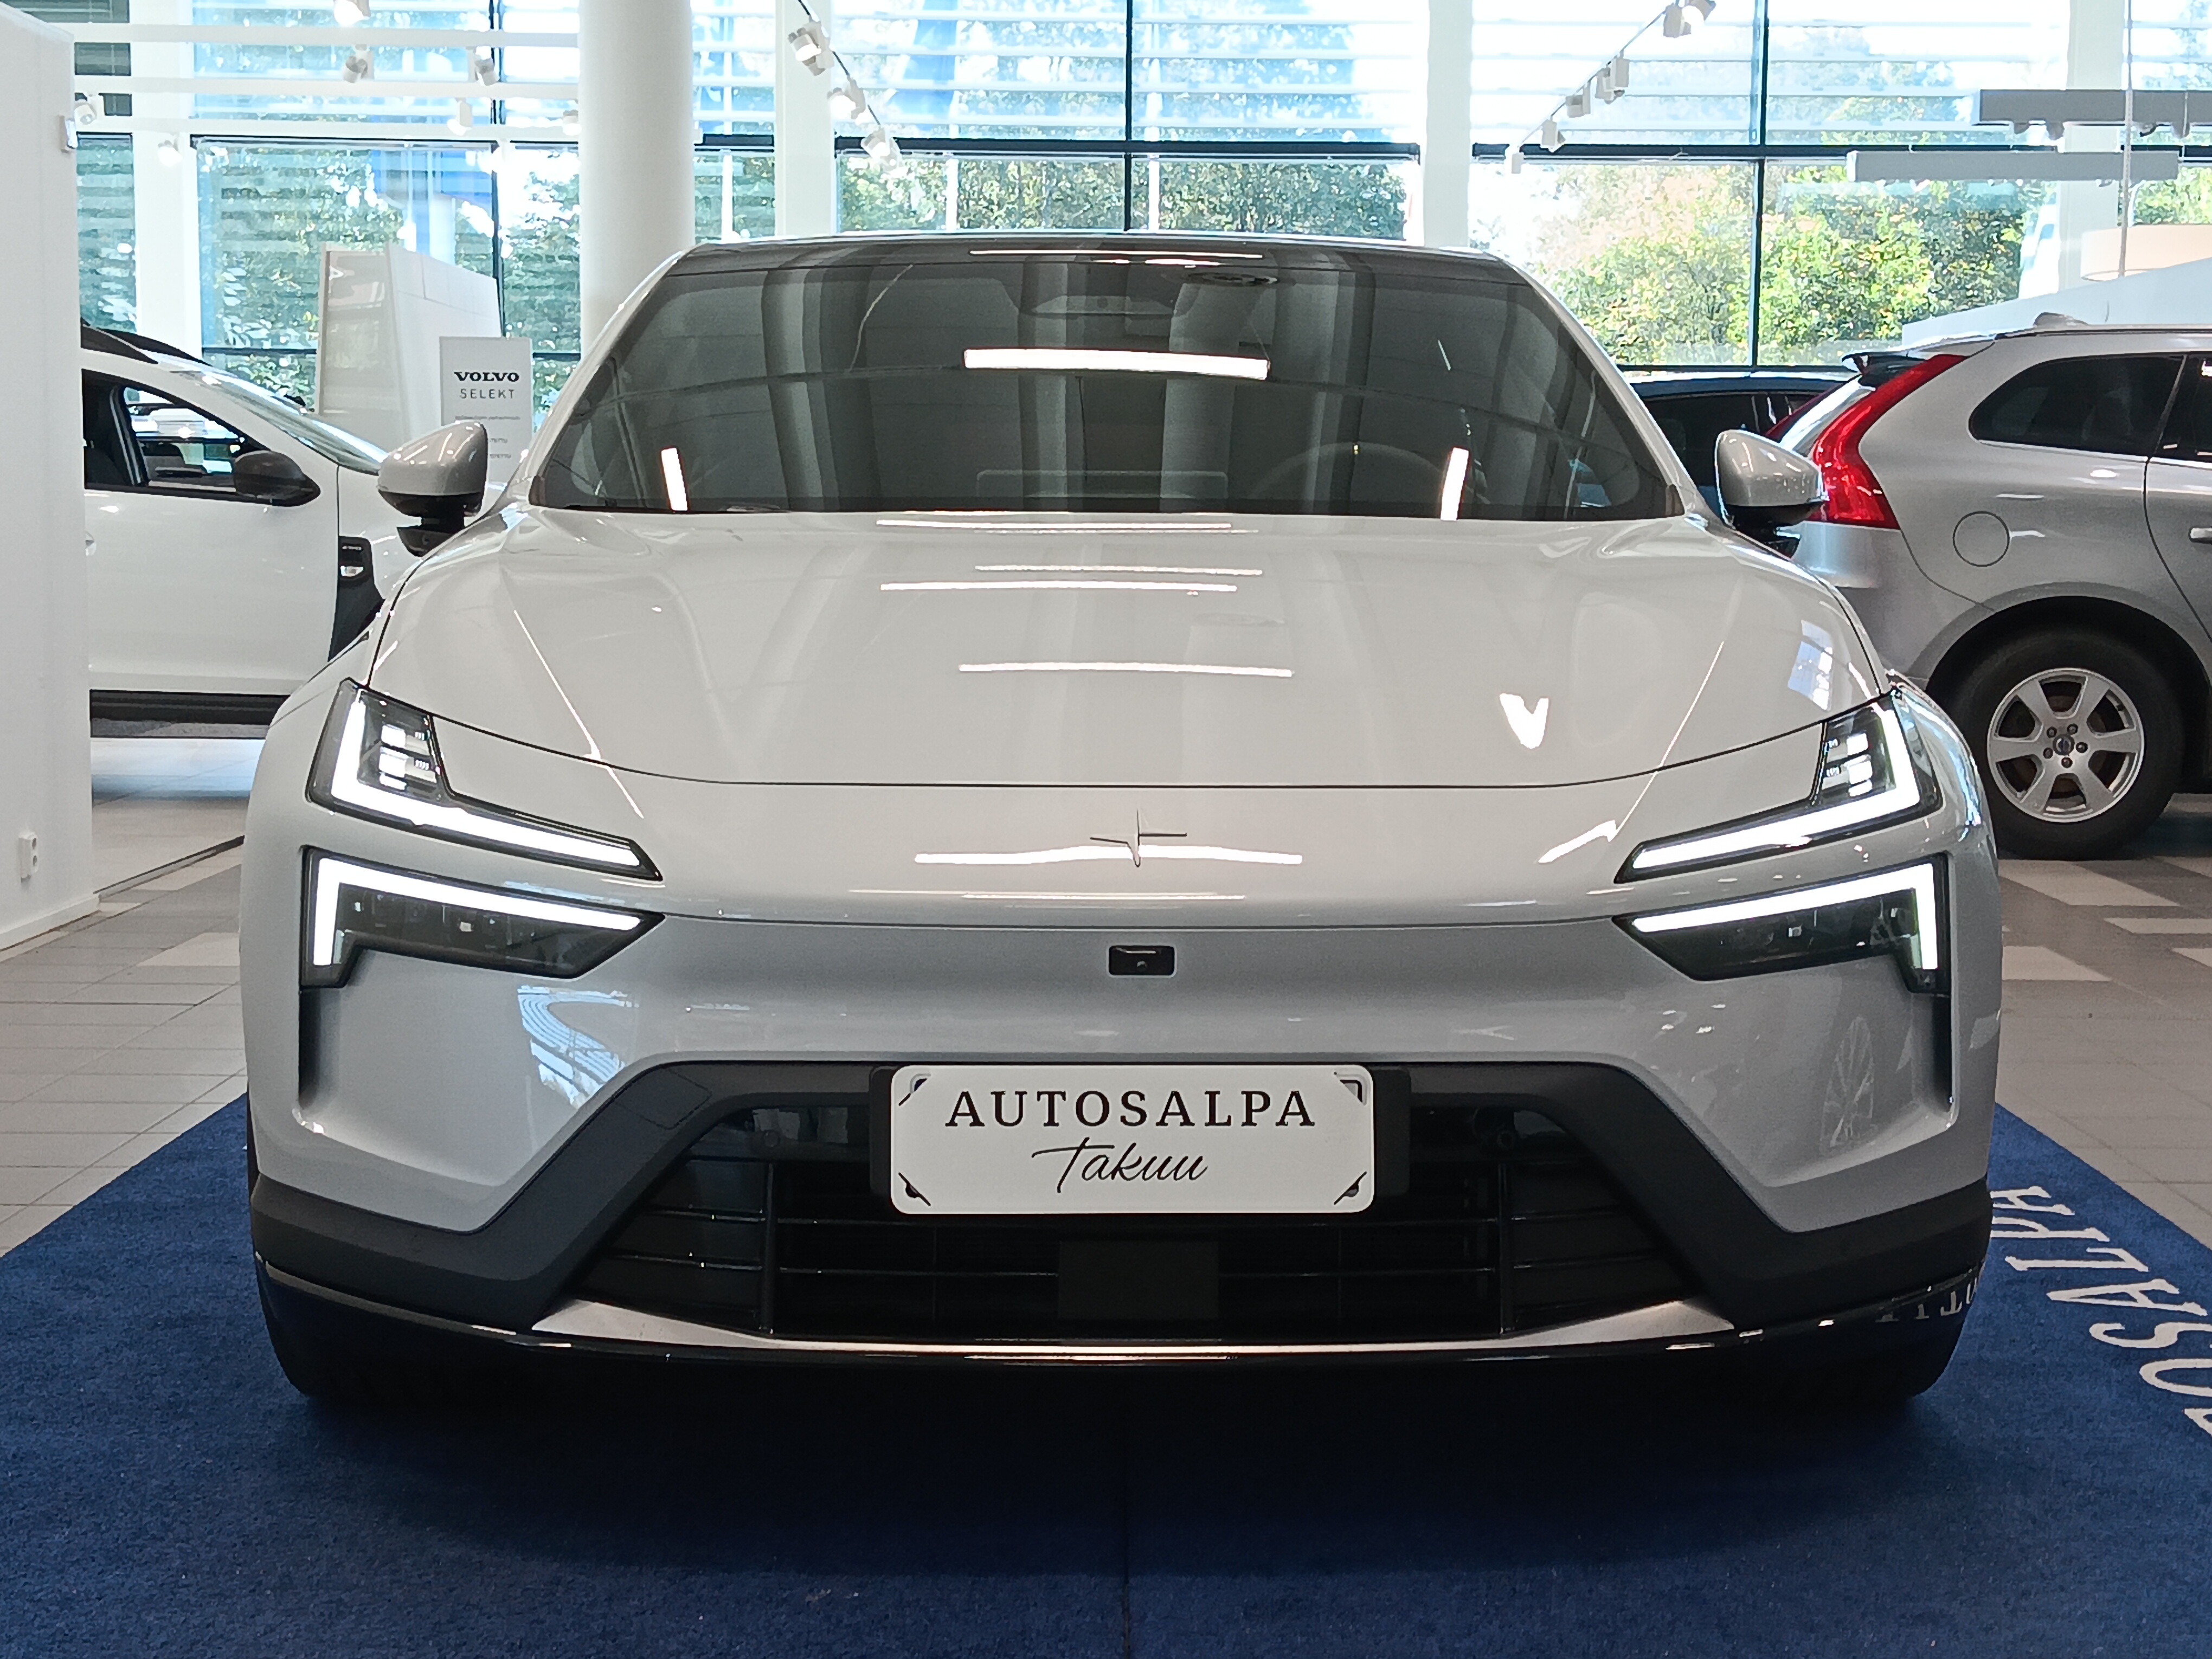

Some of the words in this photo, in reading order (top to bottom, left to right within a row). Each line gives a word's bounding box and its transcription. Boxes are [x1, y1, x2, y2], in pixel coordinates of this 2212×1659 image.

[454, 371, 519, 382] VOLVO
[460, 388, 515, 399] SELEKT
[945, 1090, 1315, 1127] AUTOSALPA
[1031, 1136, 1208, 1193] Takuu
